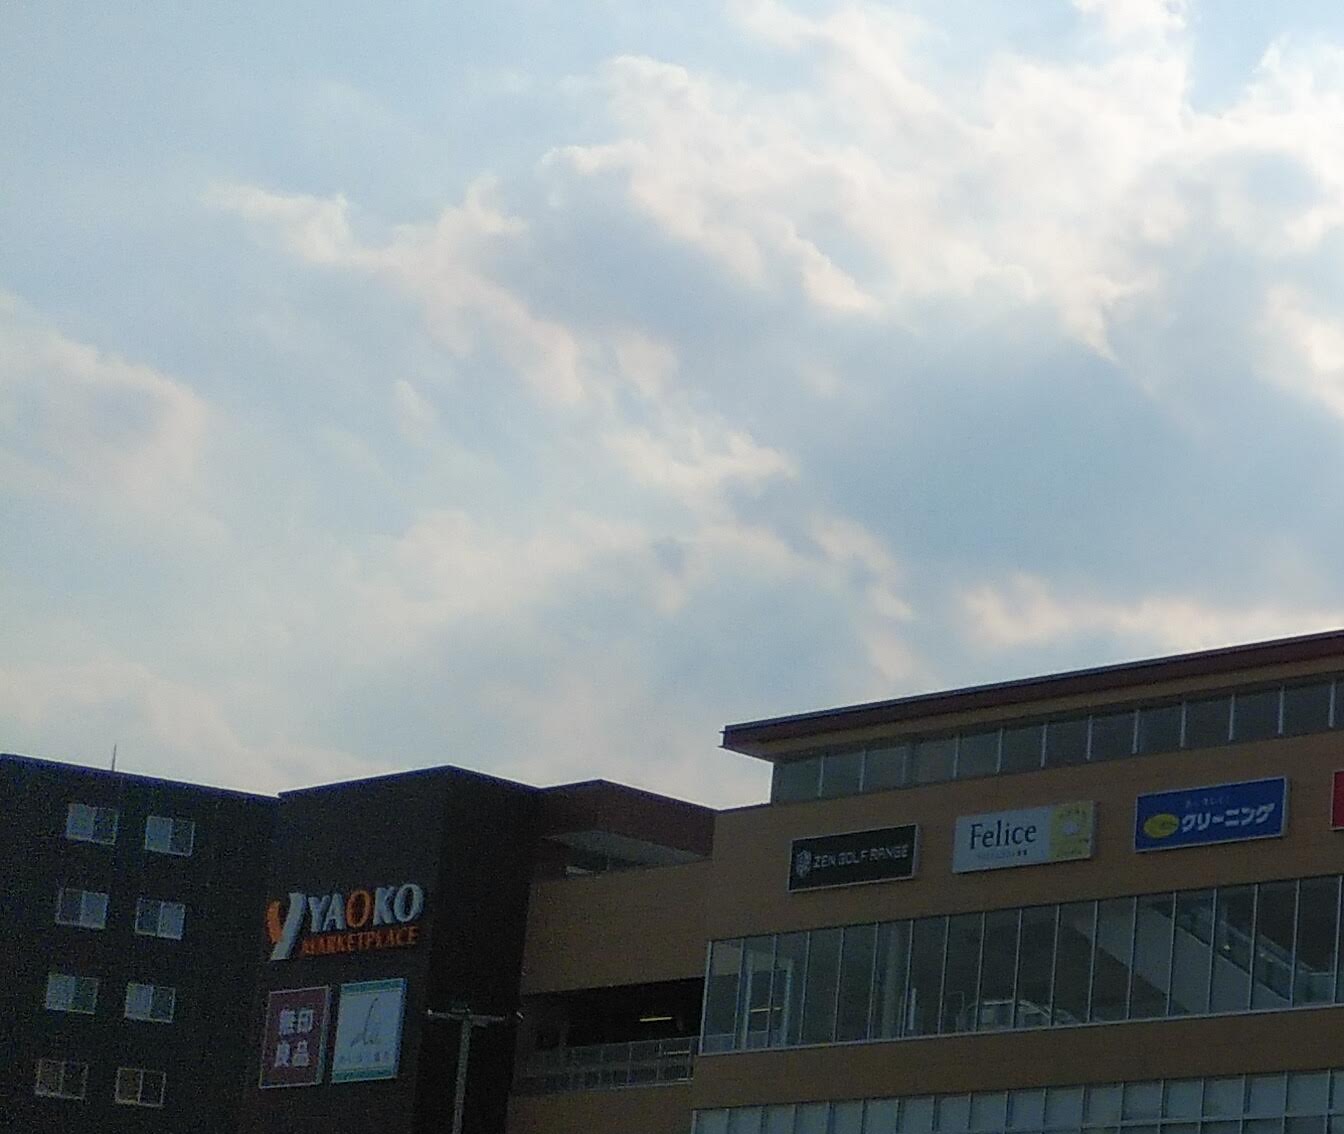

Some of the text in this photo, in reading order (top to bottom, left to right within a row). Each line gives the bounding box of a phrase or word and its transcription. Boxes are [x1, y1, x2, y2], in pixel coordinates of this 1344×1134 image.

[1181, 802, 1276, 833] クリーニング
[969, 818, 1038, 850] Felice
[308, 884, 424, 932] YAOKO
